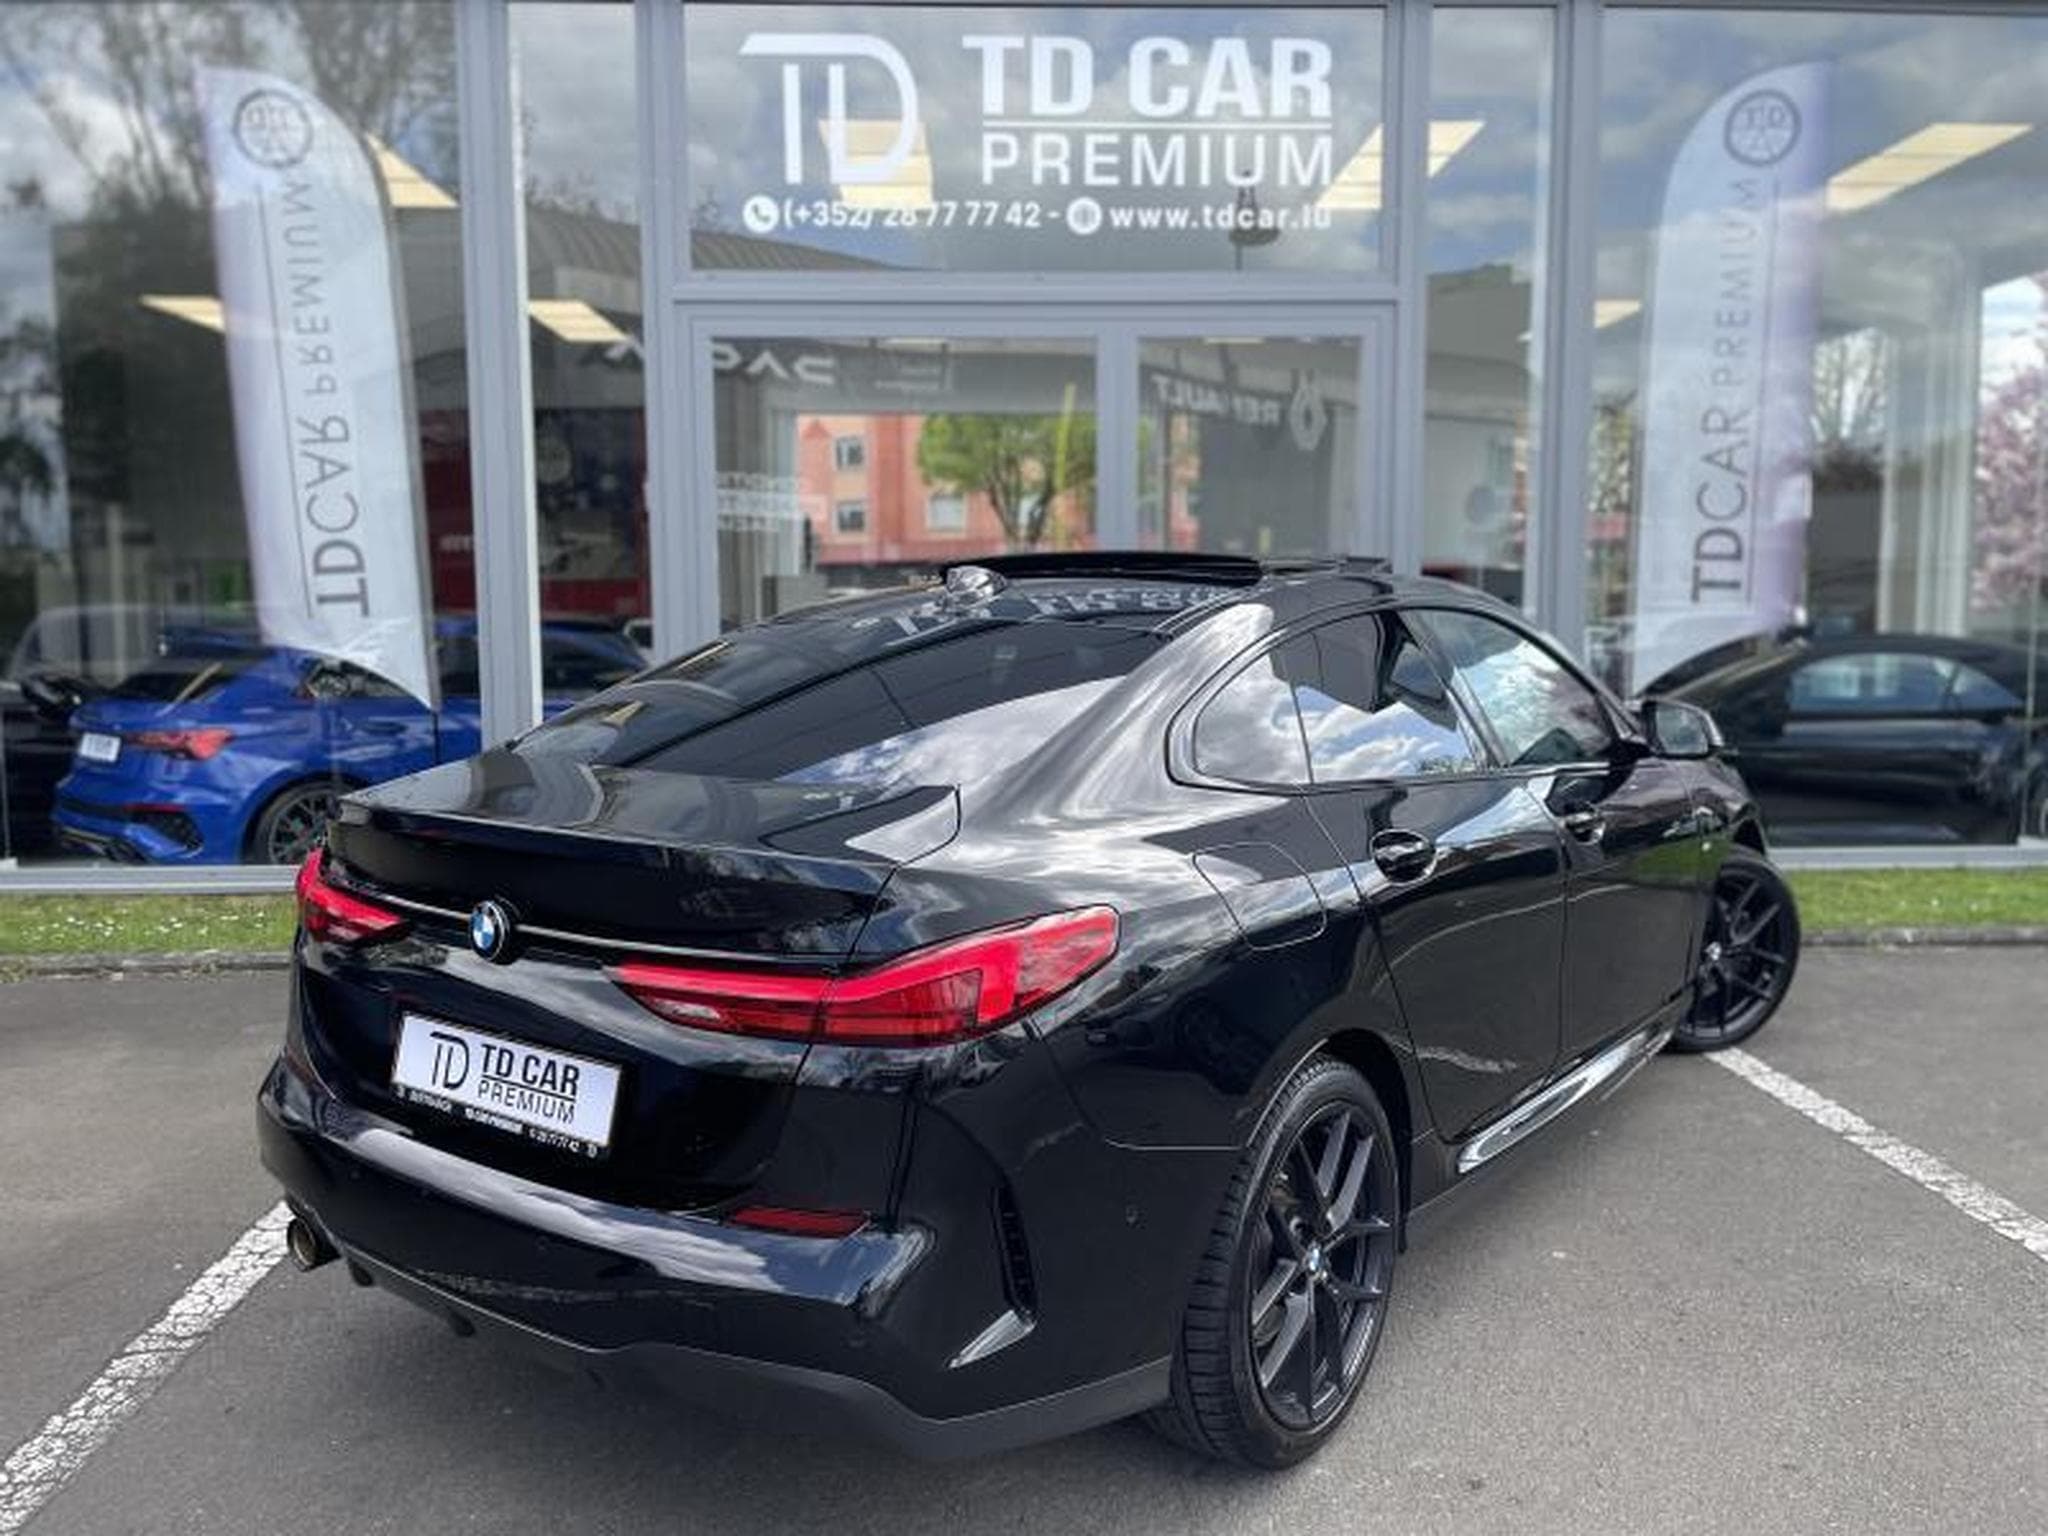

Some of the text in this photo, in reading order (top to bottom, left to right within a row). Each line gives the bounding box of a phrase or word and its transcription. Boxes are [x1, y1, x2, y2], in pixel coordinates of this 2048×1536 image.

[962, 36, 1332, 117] TD CAR
[982, 133, 1332, 186] PREMIUM
[926, 200, 959, 227] 77
[965, 200, 1000, 227] 77
[1003, 200, 1041, 228] 42
[1109, 200, 1332, 229] www.tdcar.lu
[1712, 176, 1761, 388] PREMIUM
[1690, 404, 1754, 607] TDCAR
[481, 1043, 580, 1098] TD CAR
[477, 1079, 575, 1125] PREMIUM
